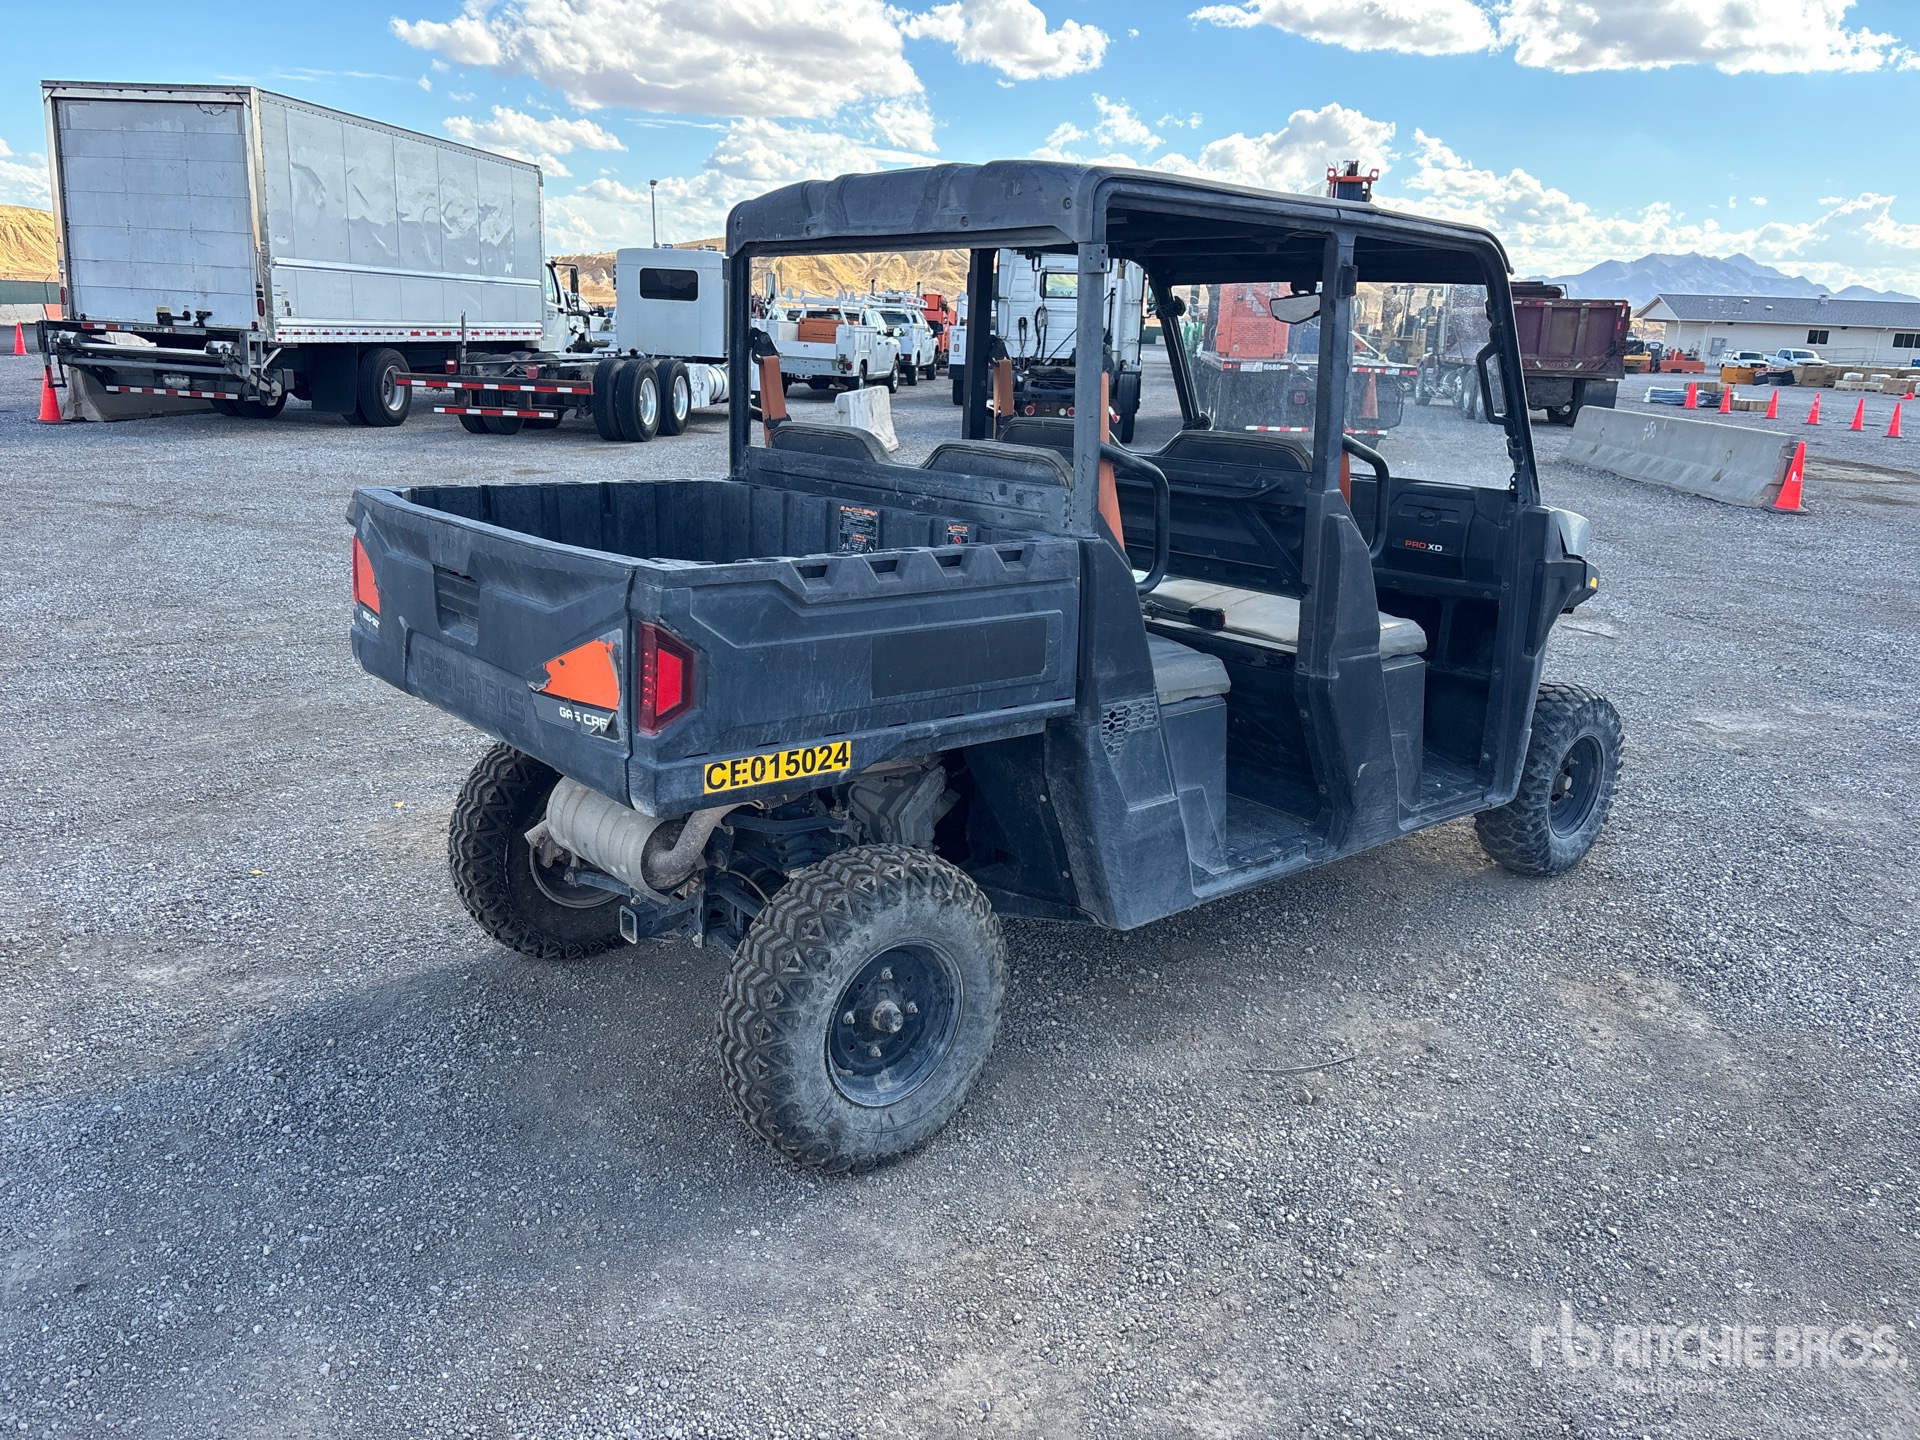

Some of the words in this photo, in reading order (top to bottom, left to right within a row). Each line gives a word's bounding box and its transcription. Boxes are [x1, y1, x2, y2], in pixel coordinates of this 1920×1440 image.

[1405, 540, 1427, 549] PRO
[1427, 543, 1443, 552] XD
[419, 649, 526, 725] POLARIS
[559, 706, 581, 723] GAS
[706, 742, 849, 790] CE015024
